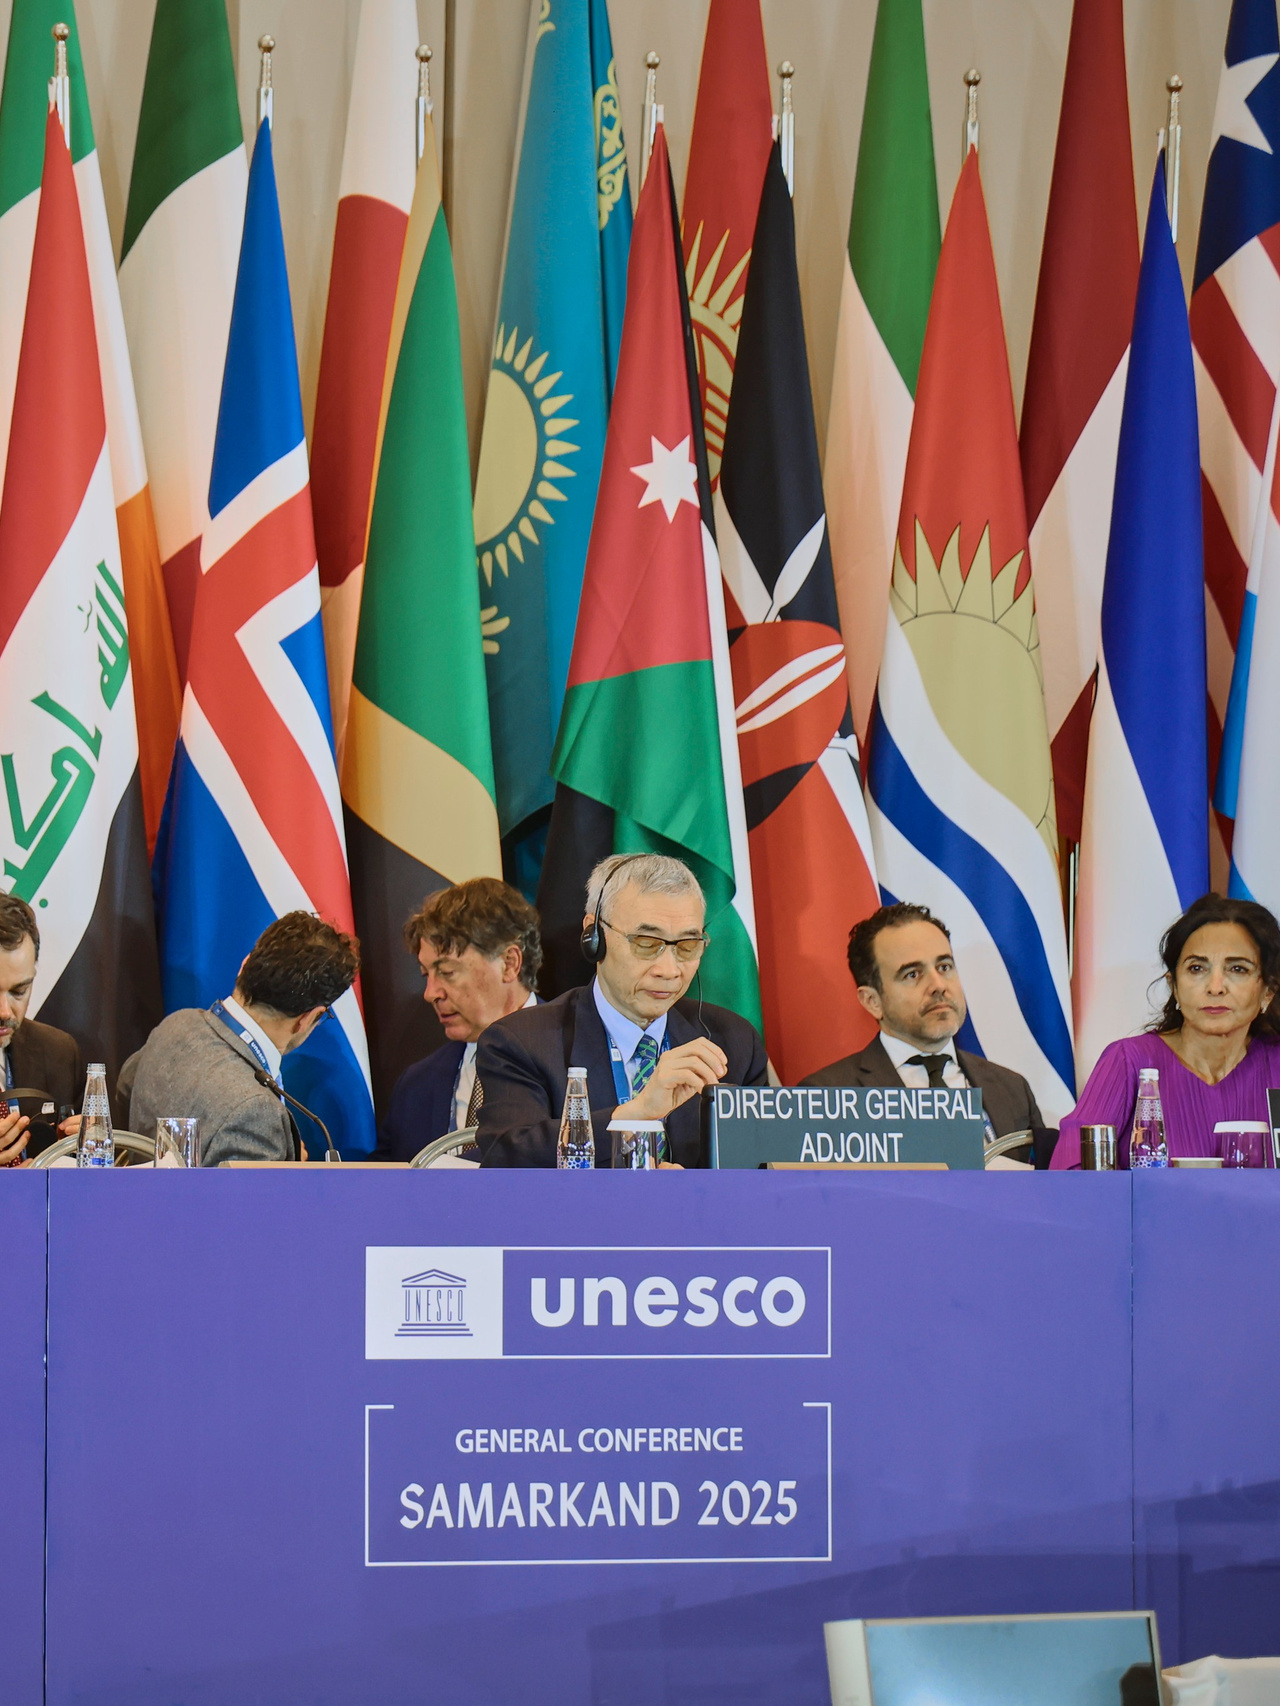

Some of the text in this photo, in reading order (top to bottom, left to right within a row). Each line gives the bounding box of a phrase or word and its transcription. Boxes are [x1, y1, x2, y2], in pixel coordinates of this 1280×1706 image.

[250, 1042, 267, 1064] unesco
[718, 1088, 981, 1120] DIRECTEUR GENERAL
[800, 1132, 904, 1163] ADJOINT
[404, 1289, 464, 1322] UNESCO
[530, 1276, 806, 1328] unesco
[455, 1427, 744, 1454] GENERAL CONFERENCE
[399, 1480, 798, 1529] SAMARKAND 2025
